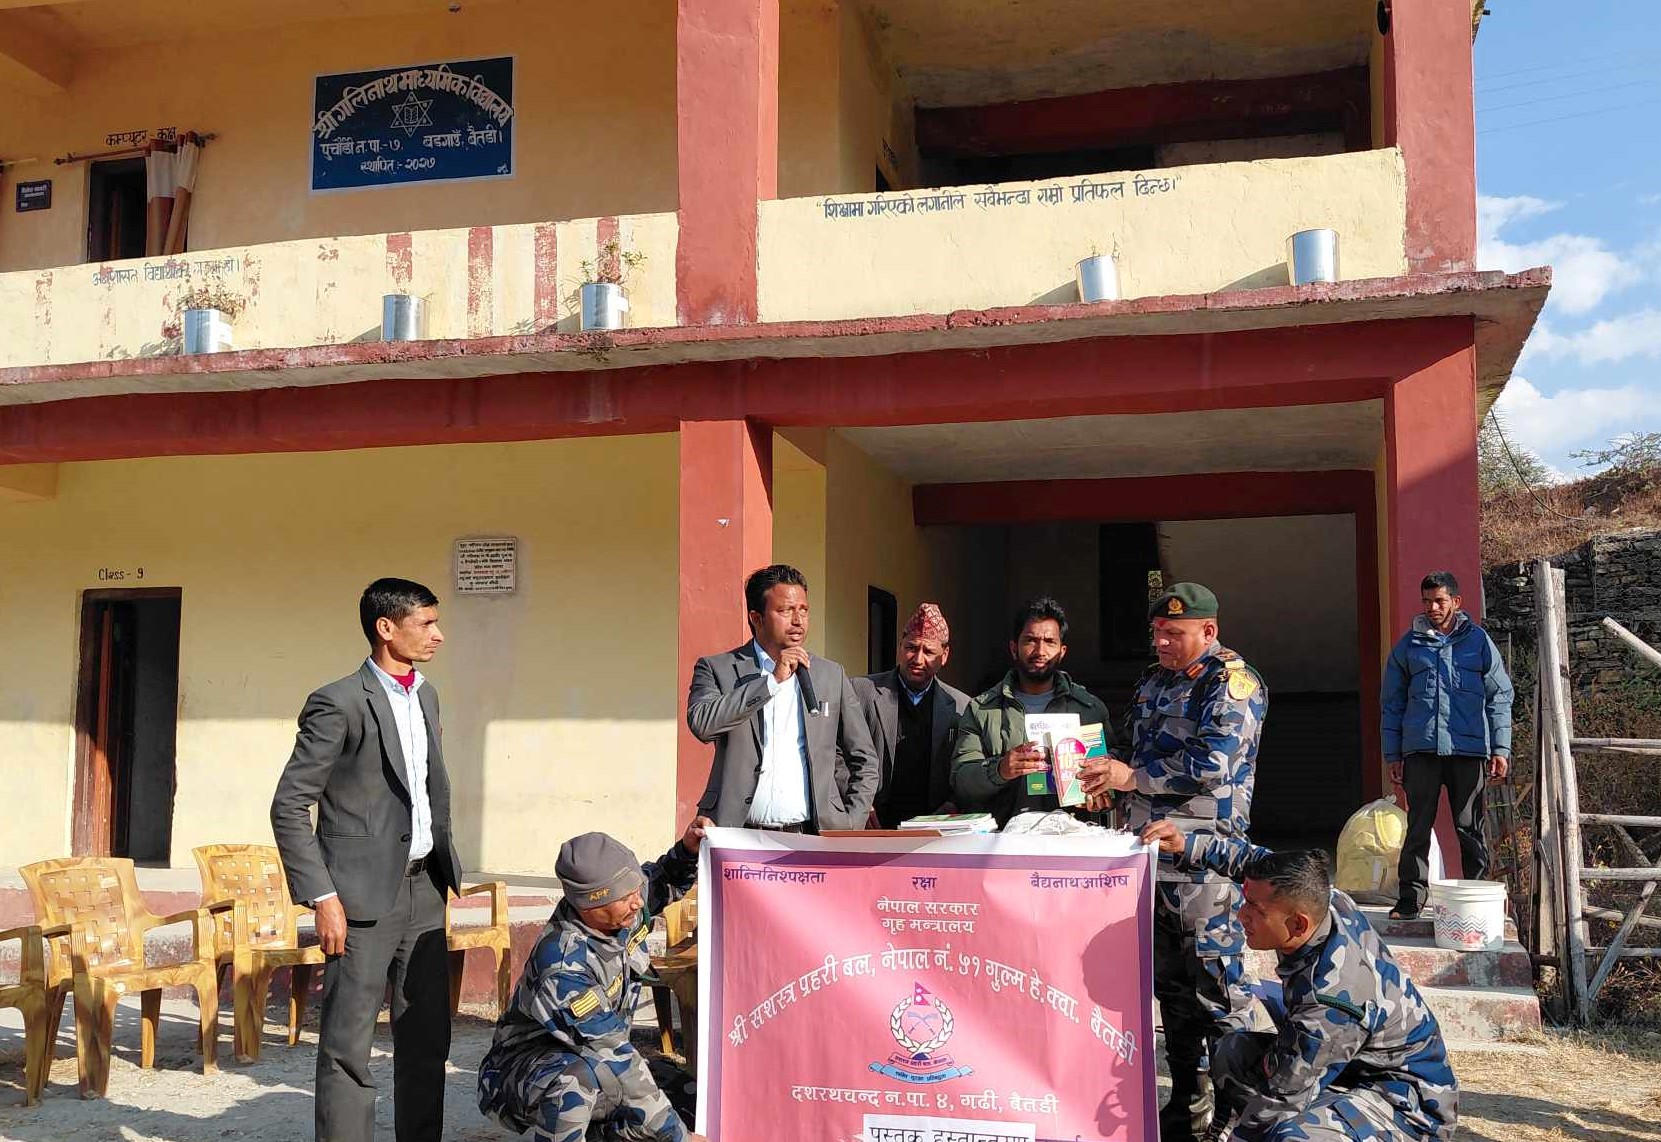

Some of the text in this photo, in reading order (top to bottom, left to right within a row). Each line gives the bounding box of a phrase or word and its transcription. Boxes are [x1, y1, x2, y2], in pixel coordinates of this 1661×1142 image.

[1070, 179, 1126, 203] प्रतिफल
[911, 875, 938, 890] रक्षा
[876, 895, 981, 916] नेपाल सरकार
[881, 917, 976, 935] गृह मन्त्रालय
[728, 1013, 749, 1048] श्री
[749, 980, 798, 1030] सशस्त्र
[798, 954, 840, 998] प्रहरी
[881, 942, 931, 971] नेपाल
[957, 951, 981, 978] ५१
[985, 958, 1028, 993] गुल्म
[1089, 1004, 1138, 1066] बैतडी
[1007, 1090, 1062, 1114] बैतडी
